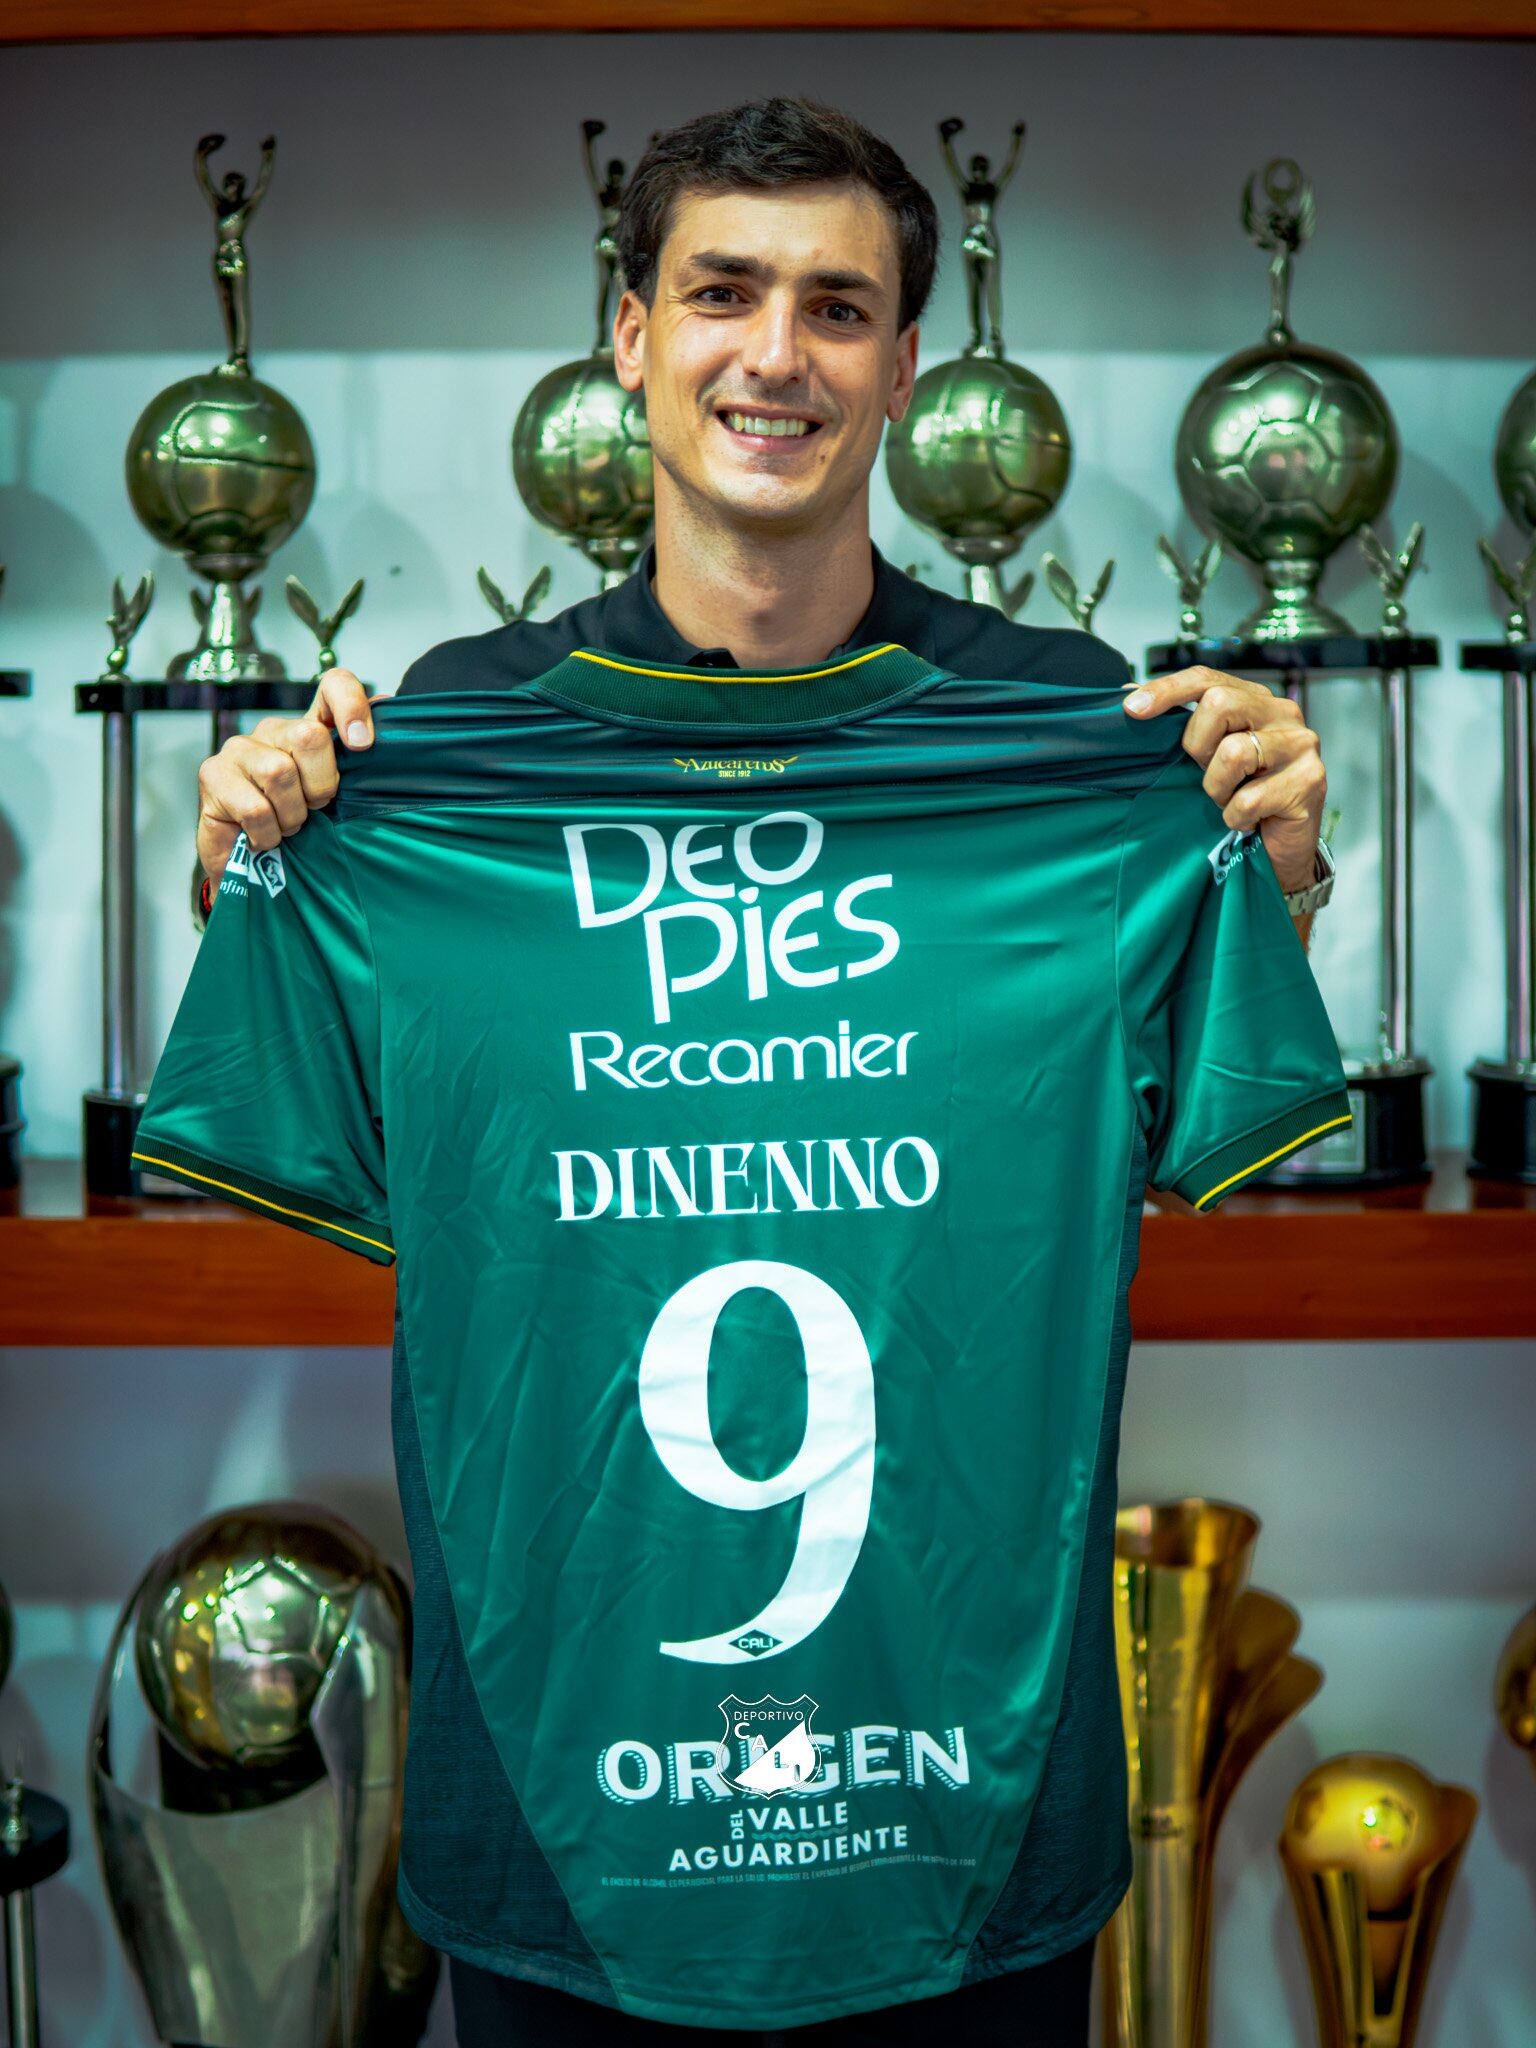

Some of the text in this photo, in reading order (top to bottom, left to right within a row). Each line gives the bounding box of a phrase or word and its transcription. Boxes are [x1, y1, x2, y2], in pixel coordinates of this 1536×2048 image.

[718, 769, 751, 778] SINCE 1912
[569, 1020, 919, 1091] Recamier
[550, 1136, 940, 1221] DINENNO
[637, 1260, 876, 1664] 9
[738, 1638, 774, 1649] CALI
[730, 1801, 848, 1840] DEL VALLE
[668, 1825, 908, 1872] AGUARDIENTE
